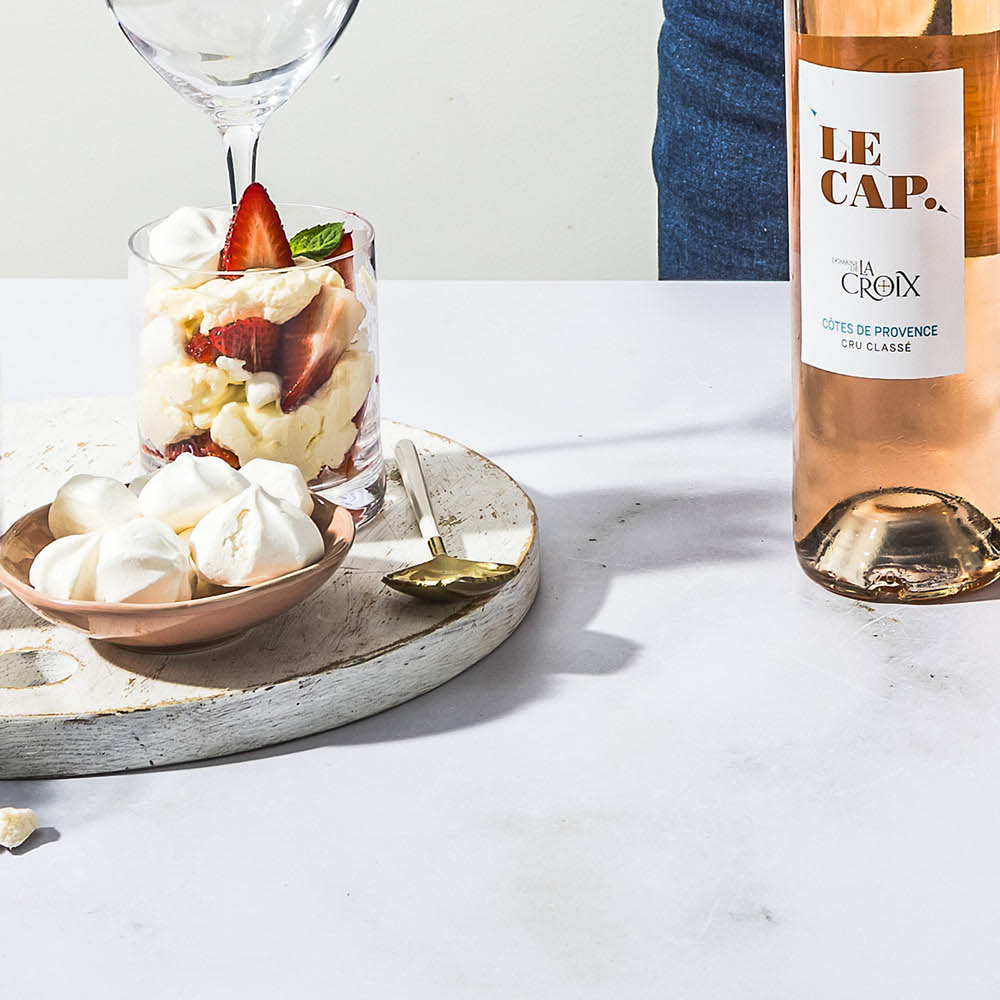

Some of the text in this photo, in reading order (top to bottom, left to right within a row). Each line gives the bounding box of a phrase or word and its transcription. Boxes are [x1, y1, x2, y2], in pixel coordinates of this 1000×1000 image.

[819, 124, 881, 166] LE
[820, 169, 938, 211] CAP.
[859, 259, 875, 277] LA
[841, 270, 921, 302] CROIX
[822, 317, 939, 338] CÔTES DE PROVENCE
[841, 338, 912, 353] CRU CLASSÉ
